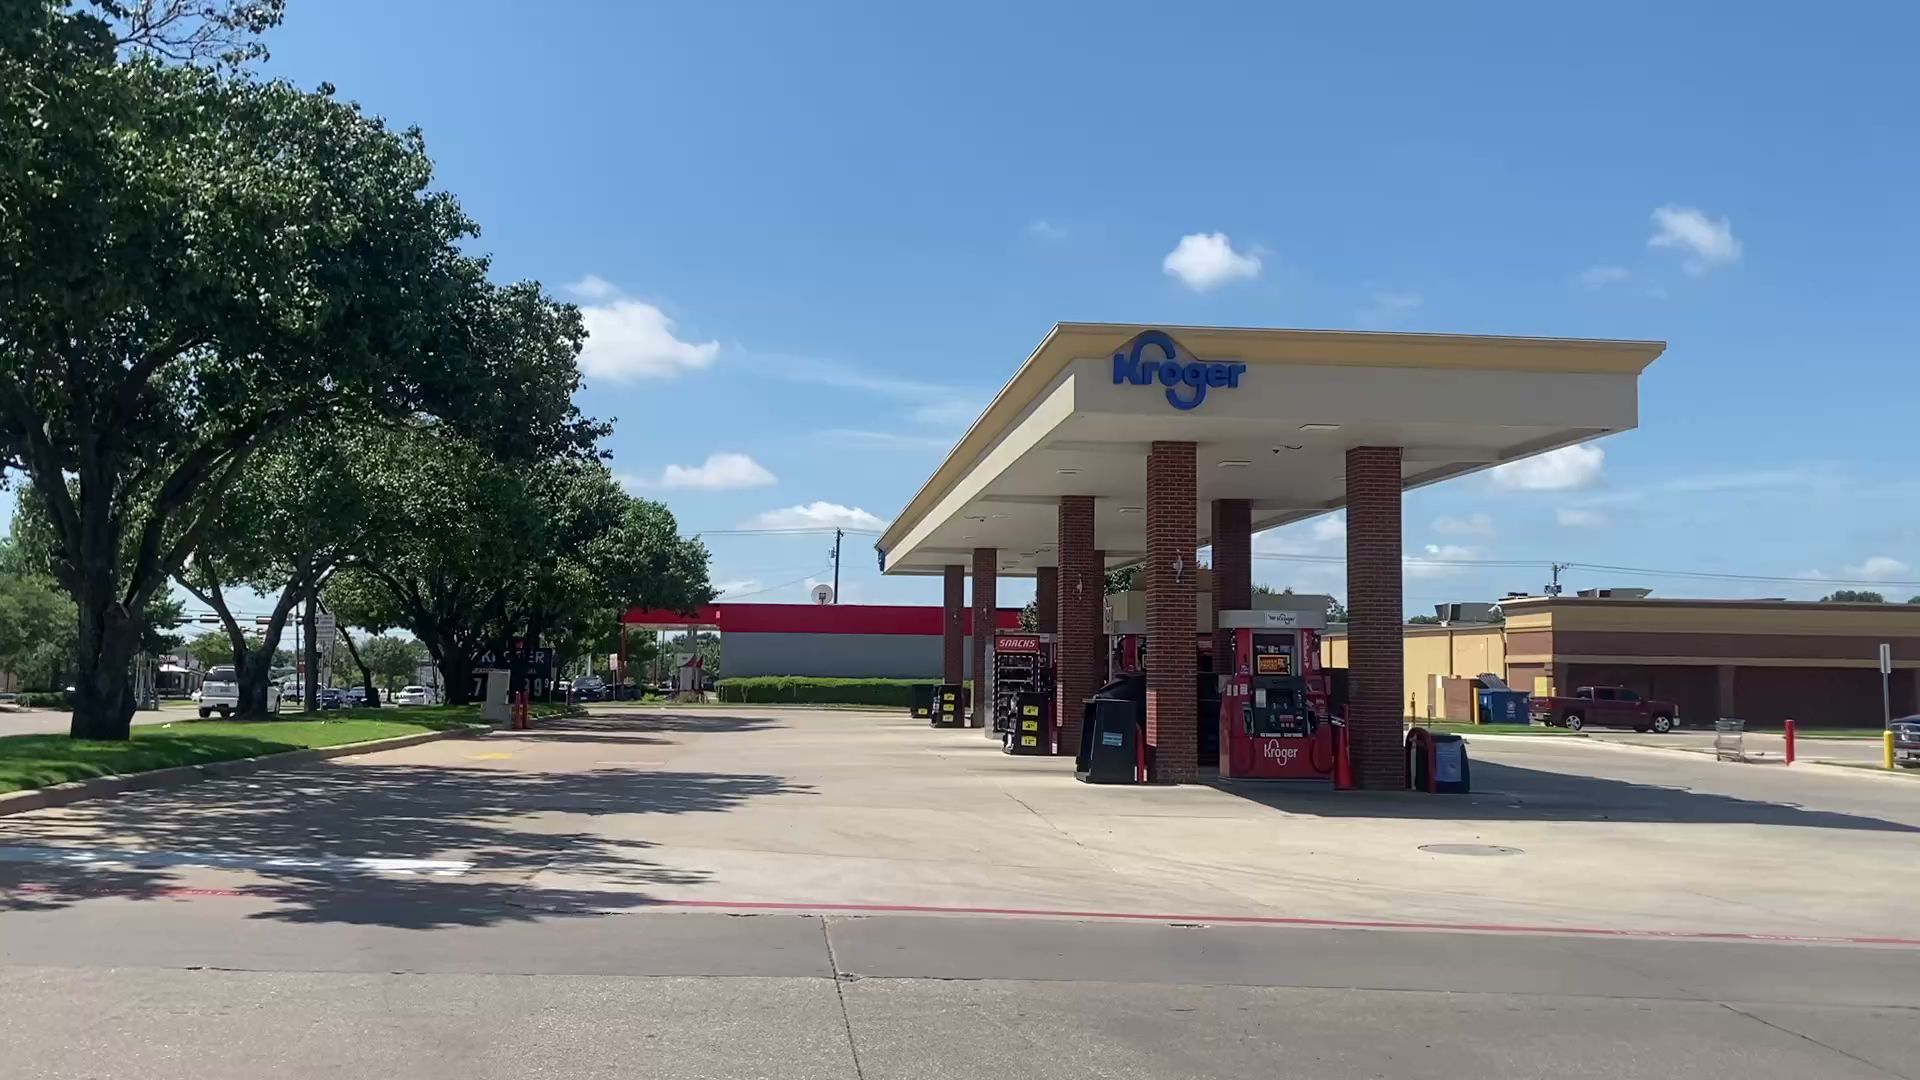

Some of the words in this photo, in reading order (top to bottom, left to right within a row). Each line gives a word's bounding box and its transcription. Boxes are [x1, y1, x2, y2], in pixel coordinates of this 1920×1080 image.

[1113, 330, 1247, 411] Kroger
[999, 639, 1036, 648] SNACKS
[1264, 739, 1298, 766] Kroger
